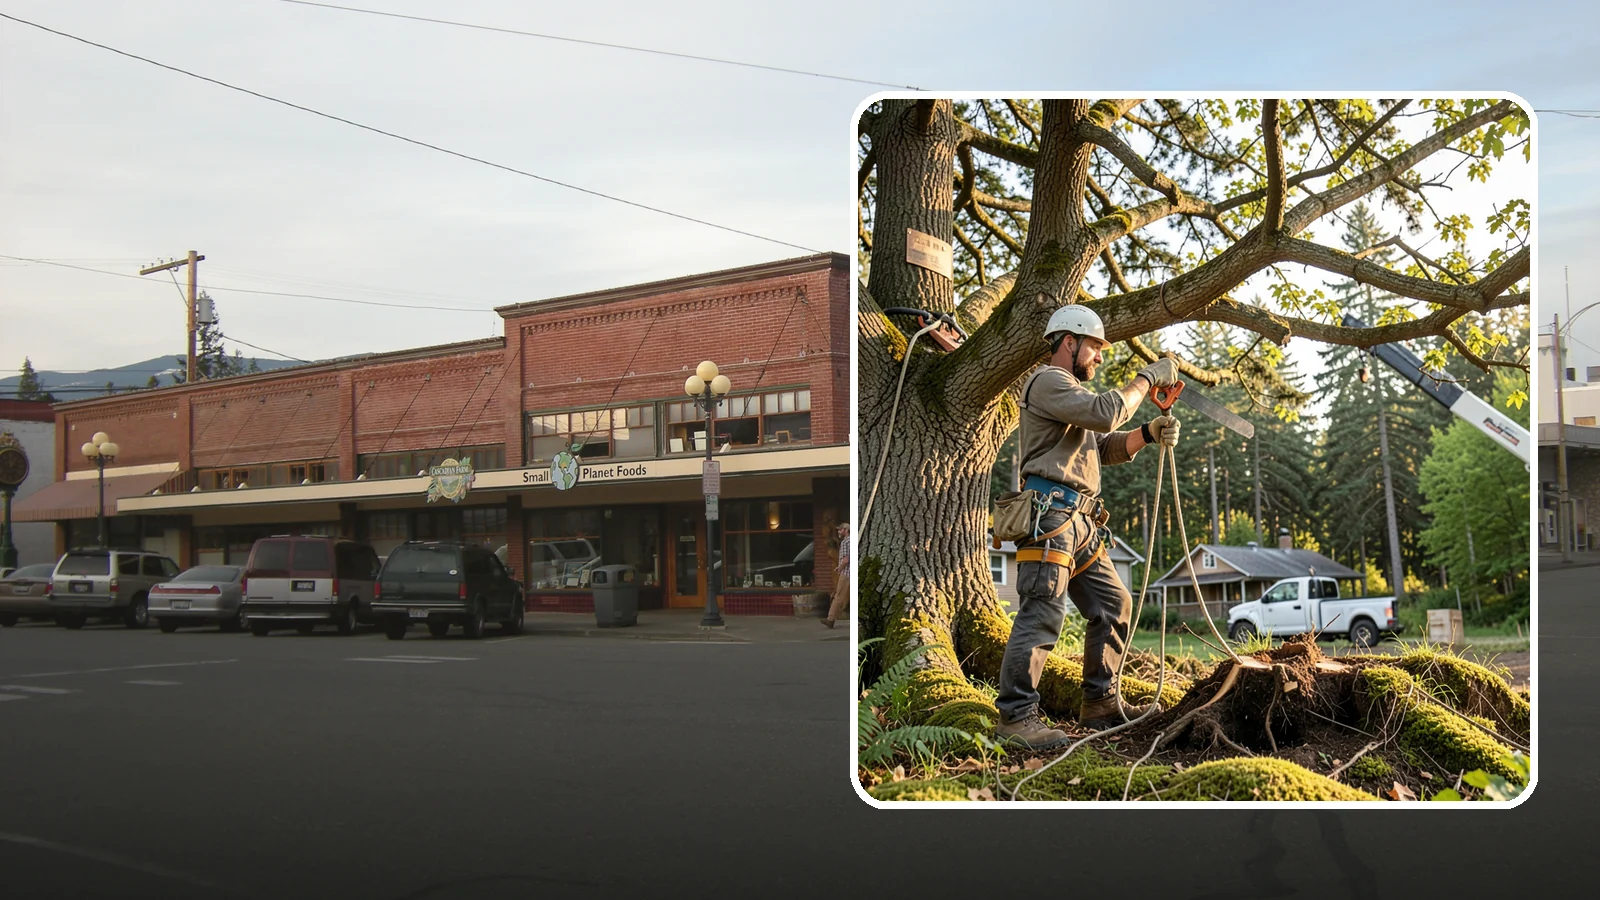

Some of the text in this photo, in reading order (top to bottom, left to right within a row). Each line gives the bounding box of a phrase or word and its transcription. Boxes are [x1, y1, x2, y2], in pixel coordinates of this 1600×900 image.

[523, 464, 646, 483] Small Planet Foods
